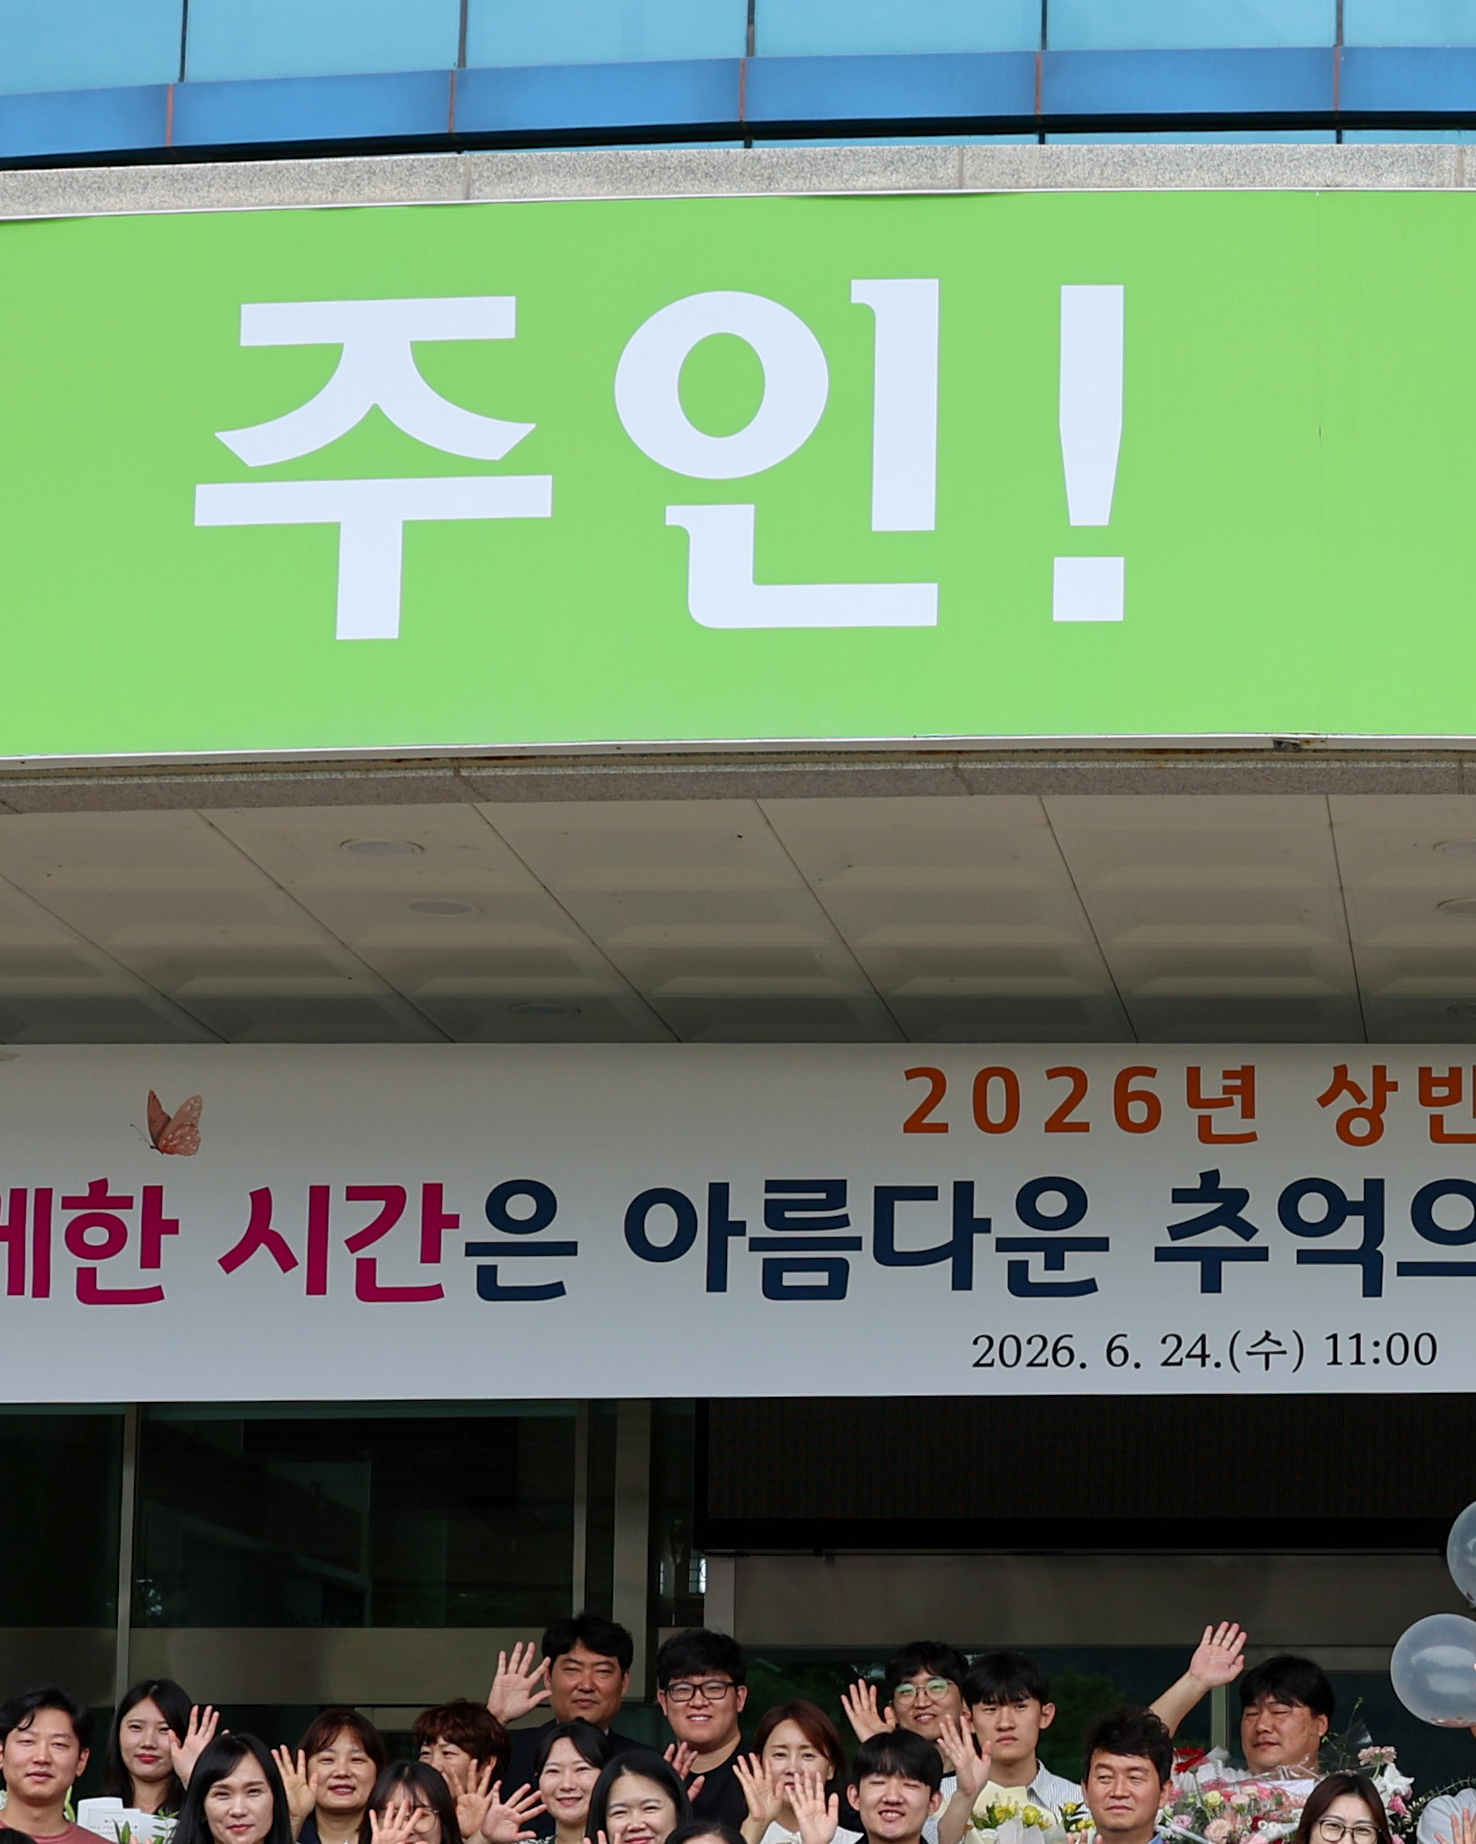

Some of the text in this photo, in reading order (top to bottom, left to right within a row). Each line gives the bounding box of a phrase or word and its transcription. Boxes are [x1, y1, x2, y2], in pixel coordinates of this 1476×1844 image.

[195, 279, 1126, 640] 주인!
[905, 1066, 1257, 1143] 2026년
[218, 1179, 578, 1302] 시간은
[624, 1176, 1109, 1300] 아름다운
[972, 1330, 1437, 1374] 2026. 6. 24.(수) 11:00
